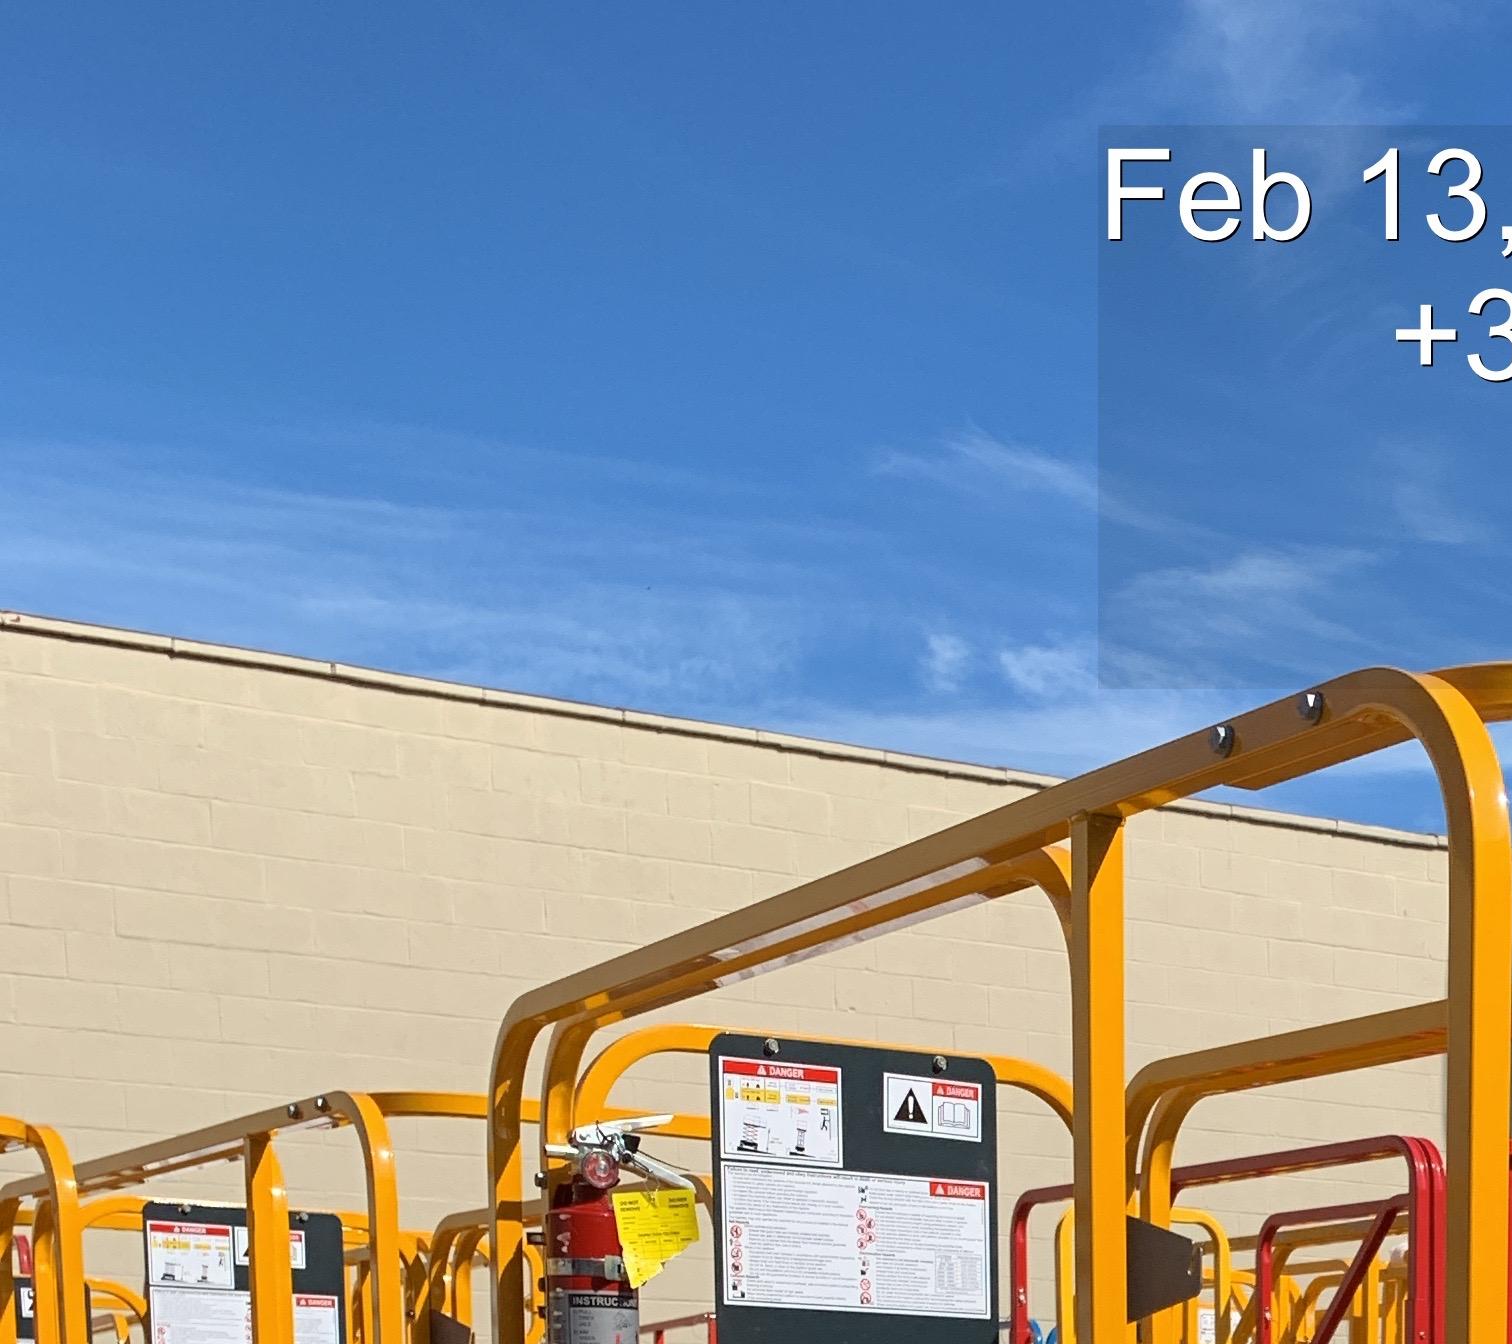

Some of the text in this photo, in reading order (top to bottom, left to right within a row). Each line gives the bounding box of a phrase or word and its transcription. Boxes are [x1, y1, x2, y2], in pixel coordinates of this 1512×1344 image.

[768, 1066, 804, 1079] DANGER
[946, 1085, 976, 1098] DANGER
[946, 1185, 981, 1198] DANGER
[573, 1296, 636, 1308] INSTRUC
